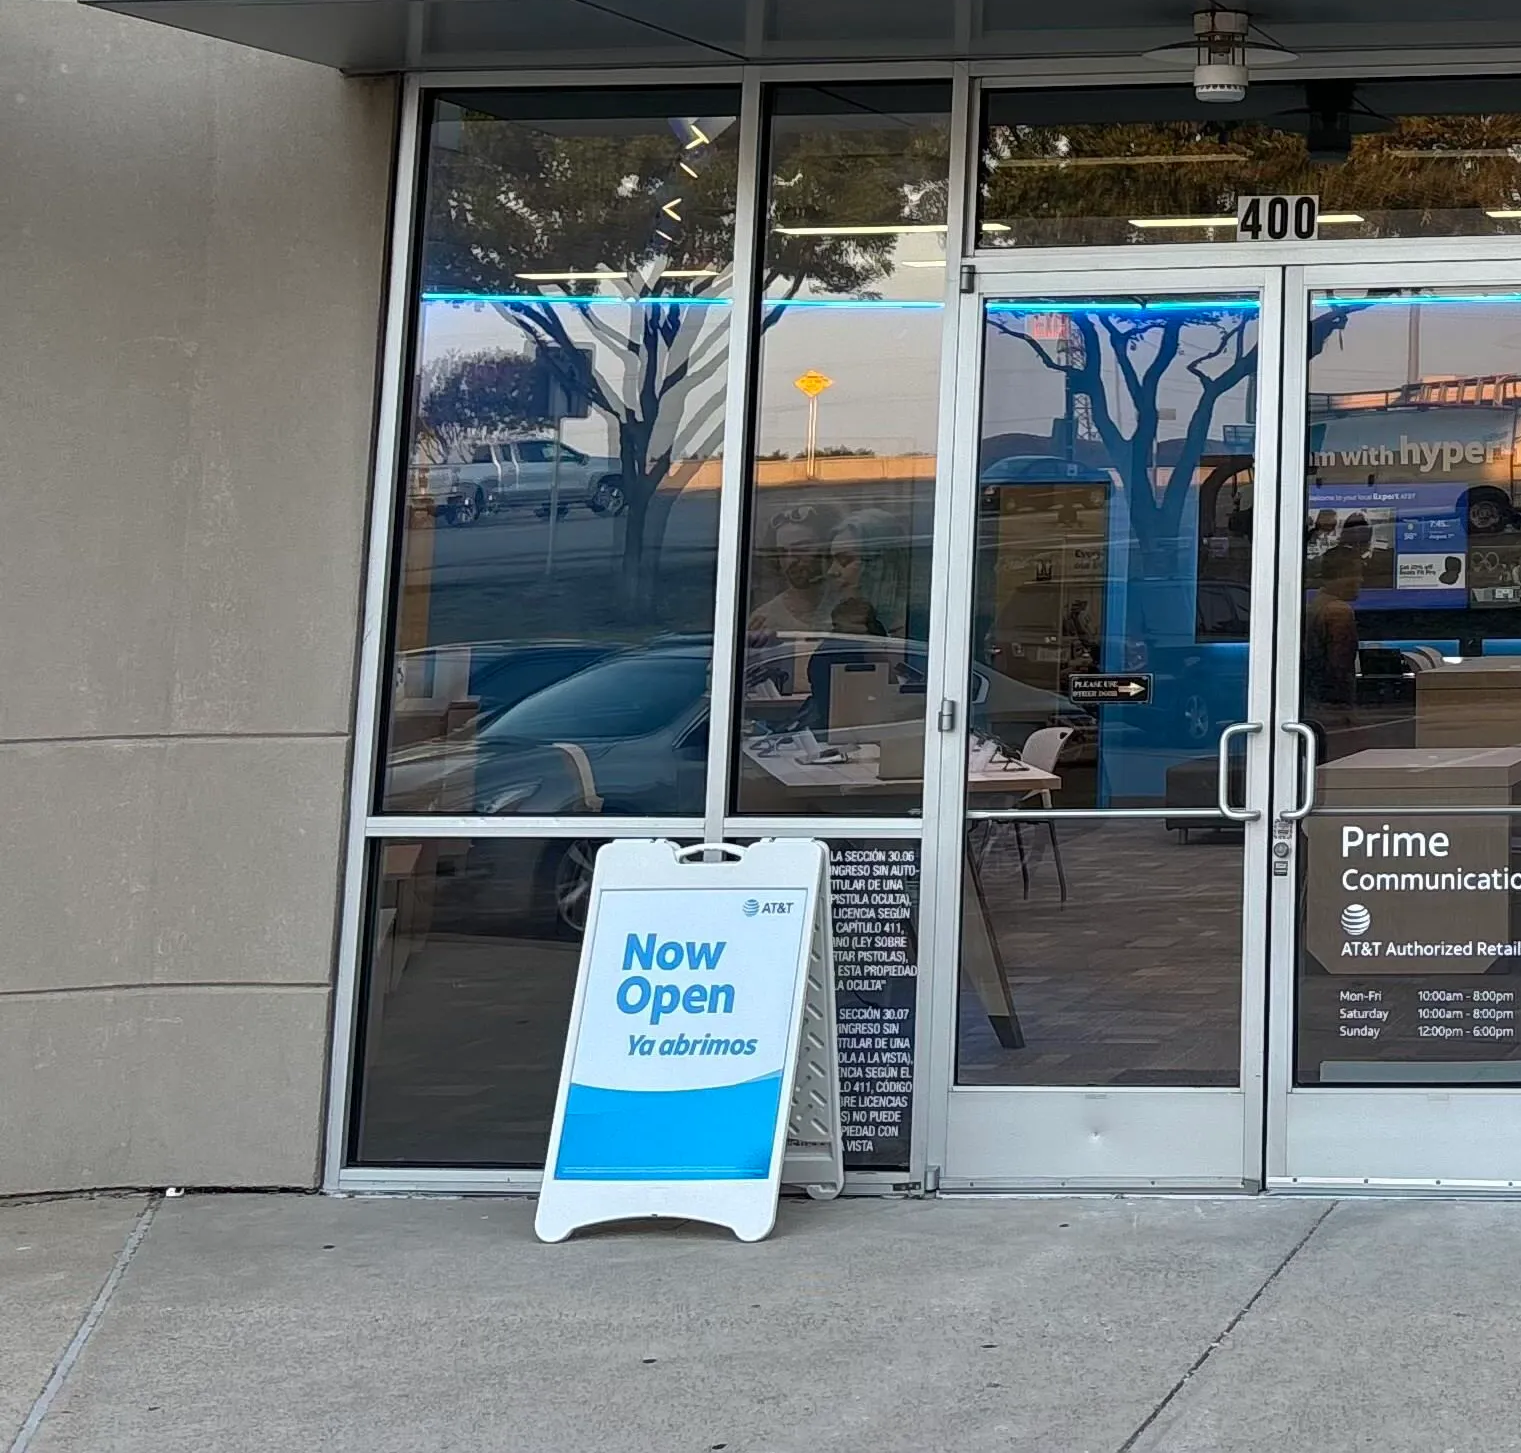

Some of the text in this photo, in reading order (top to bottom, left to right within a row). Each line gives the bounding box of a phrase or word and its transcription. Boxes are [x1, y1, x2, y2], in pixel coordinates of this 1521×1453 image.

[1240, 196, 1316, 240] 400
[1342, 444, 1394, 466] with
[1342, 824, 1449, 857] Prime
[845, 848, 886, 862] SECCIÓN
[873, 865, 888, 876] SIN
[868, 879, 903, 890] DE UNA
[762, 901, 794, 915] AT&T
[833, 908, 875, 919] LICENCIA
[875, 936, 907, 947] SOBRE
[621, 933, 727, 971] Now
[1341, 941, 1382, 956] AT&T
[1386, 941, 1472, 956] Authorized
[838, 965, 918, 976] ESTA PROPIEDAD
[616, 975, 735, 1025] Open
[1340, 991, 1513, 1004] Mon-Fri 10:00am 8:00pm
[840, 1006, 880, 1019] SECCIÓN
[1340, 1008, 1513, 1021] Saturday 10:00am 8:00pm
[883, 1023, 899, 1034] SIN
[1340, 1026, 1513, 1039] Sunday 12:00pm 6:00pm
[627, 1034, 758, 1056] Ya abrimos
[875, 1038, 910, 1048] DE UNA
[858, 1052, 865, 1063] A
[867, 1052, 880, 1063] LA
[900, 1067, 912, 1078] EL
[859, 1096, 908, 1107] LICENCIAS
[853, 1111, 867, 1122] NO
[870, 1111, 901, 1122] PUEDE
[878, 1126, 898, 1136] CON
[846, 1140, 873, 1151] VISTA
